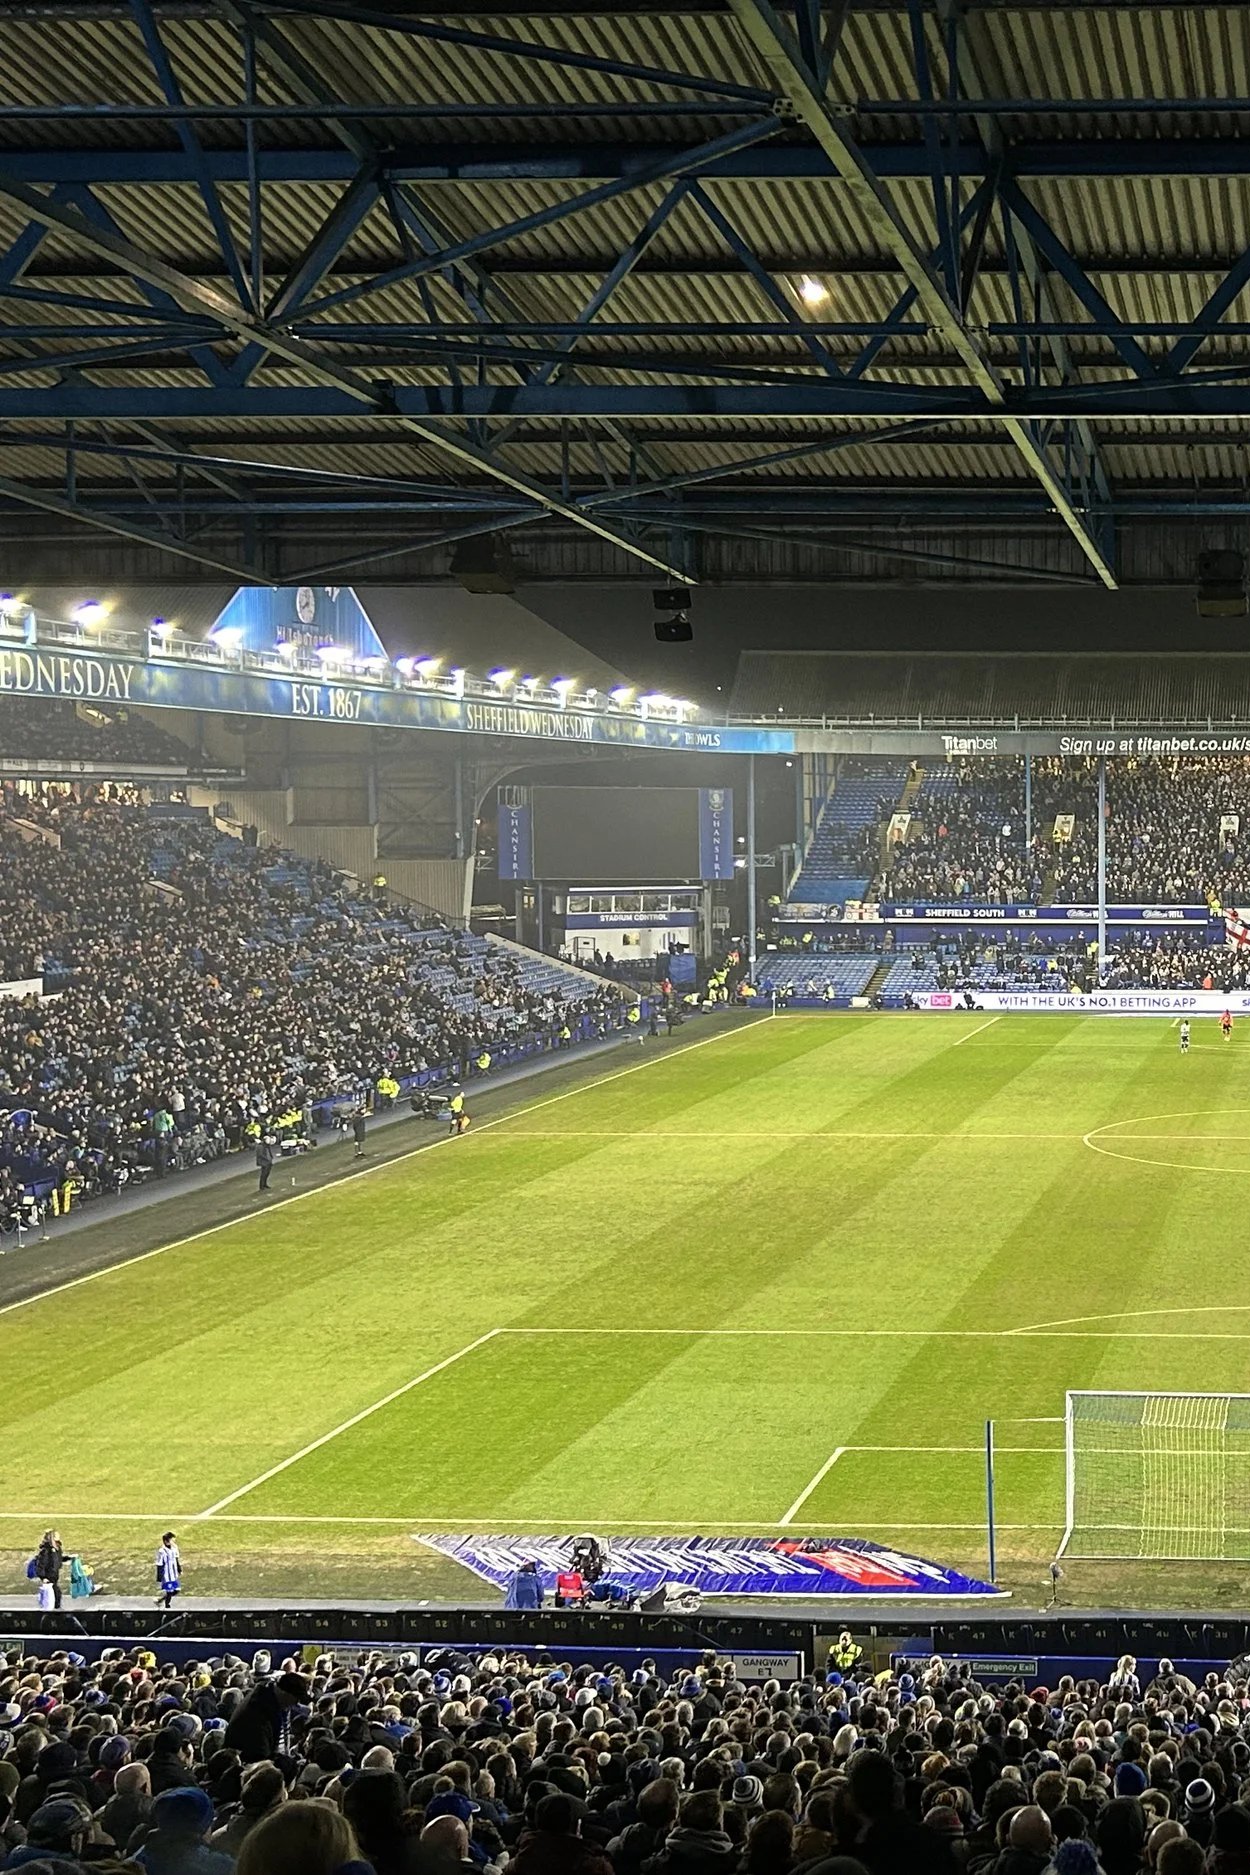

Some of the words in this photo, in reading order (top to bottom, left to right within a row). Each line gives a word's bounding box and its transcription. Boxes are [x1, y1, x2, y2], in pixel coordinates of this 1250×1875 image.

[291, 683, 324, 715] EST.
[328, 688, 362, 718] 1867
[467, 704, 529, 735] SHEFFIELD
[529, 710, 595, 740] WEDNESDAY
[695, 733, 721, 747] OWLS
[941, 736, 997, 750] Titanbet
[1060, 737, 1093, 754] Sign
[1096, 740, 1116, 754] up
[1119, 738, 1134, 751] at
[510, 810, 520, 879] CHANSIRI
[712, 812, 722, 878] CHANSIRI
[600, 914, 633, 922] STADIUM
[634, 913, 668, 922] CONTROL
[925, 909, 971, 917] SHEFFIELD
[973, 909, 1005, 917] SOUTH
[998, 996, 1028, 1006] WITH
[1032, 996, 1054, 1006] THE
[1058, 997, 1086, 1007] UK'S
[1089, 997, 1116, 1007] NO.1
[1120, 997, 1170, 1007] BETTING
[1173, 997, 1196, 1007] APP
[743, 1658, 789, 1667] GANGWAY
[972, 1662, 1018, 1672] Emergency
[1019, 1662, 1035, 1672] Exit
